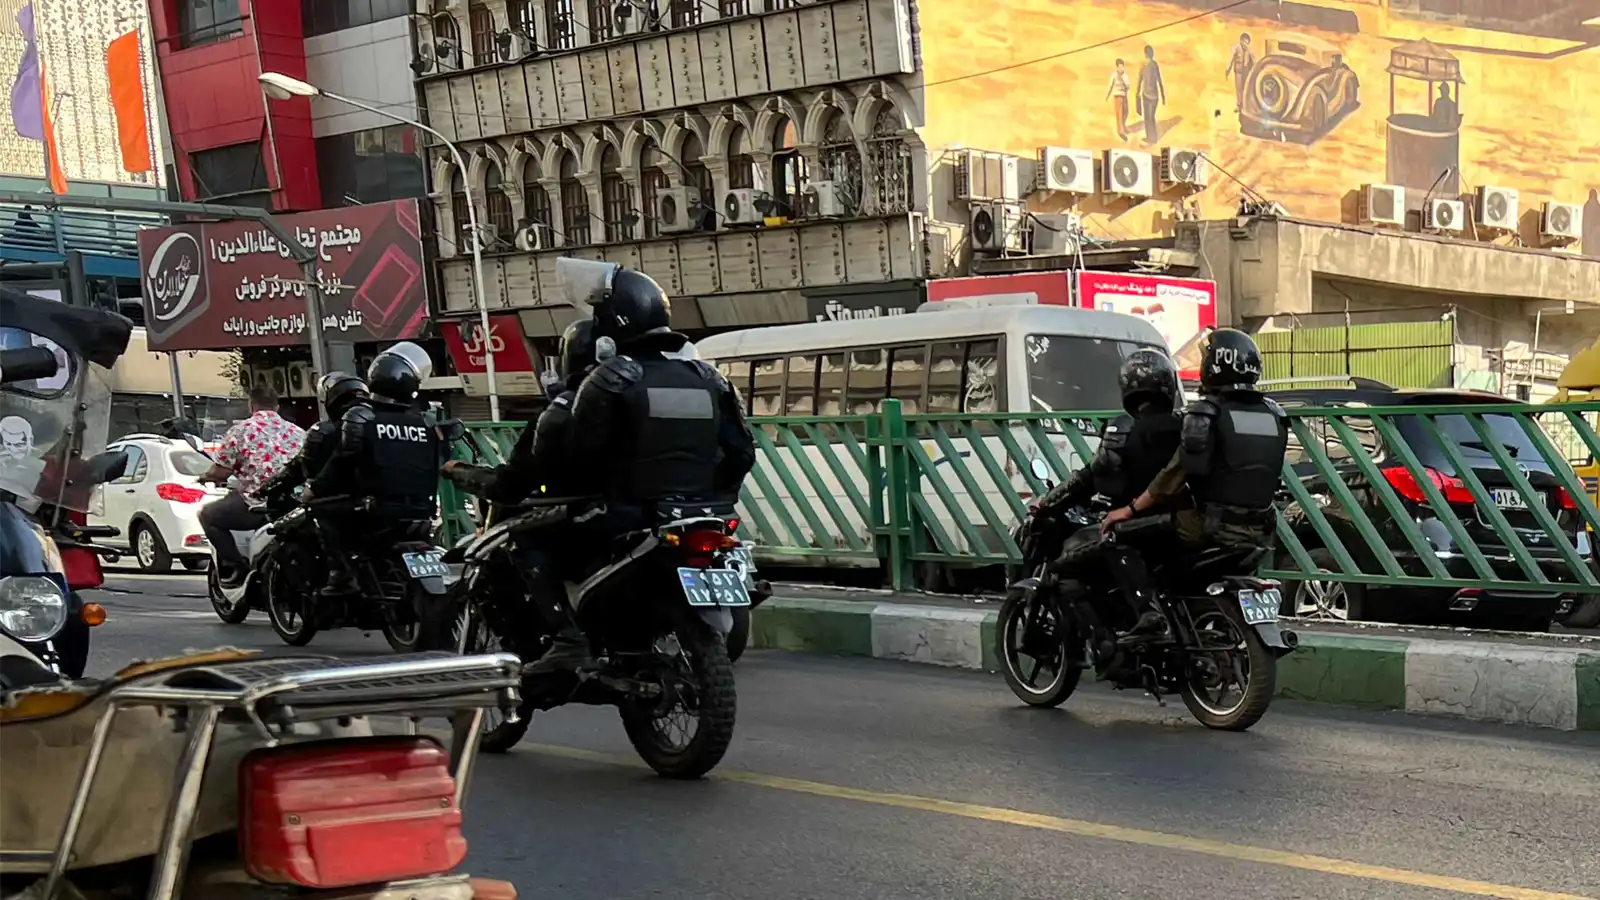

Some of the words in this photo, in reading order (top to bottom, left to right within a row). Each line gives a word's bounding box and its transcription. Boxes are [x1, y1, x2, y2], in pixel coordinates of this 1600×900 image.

[319, 224, 362, 262] مجتمع
[236, 274, 267, 300] فروش
[340, 310, 362, 331] تلفن
[376, 424, 428, 443] POLICE
